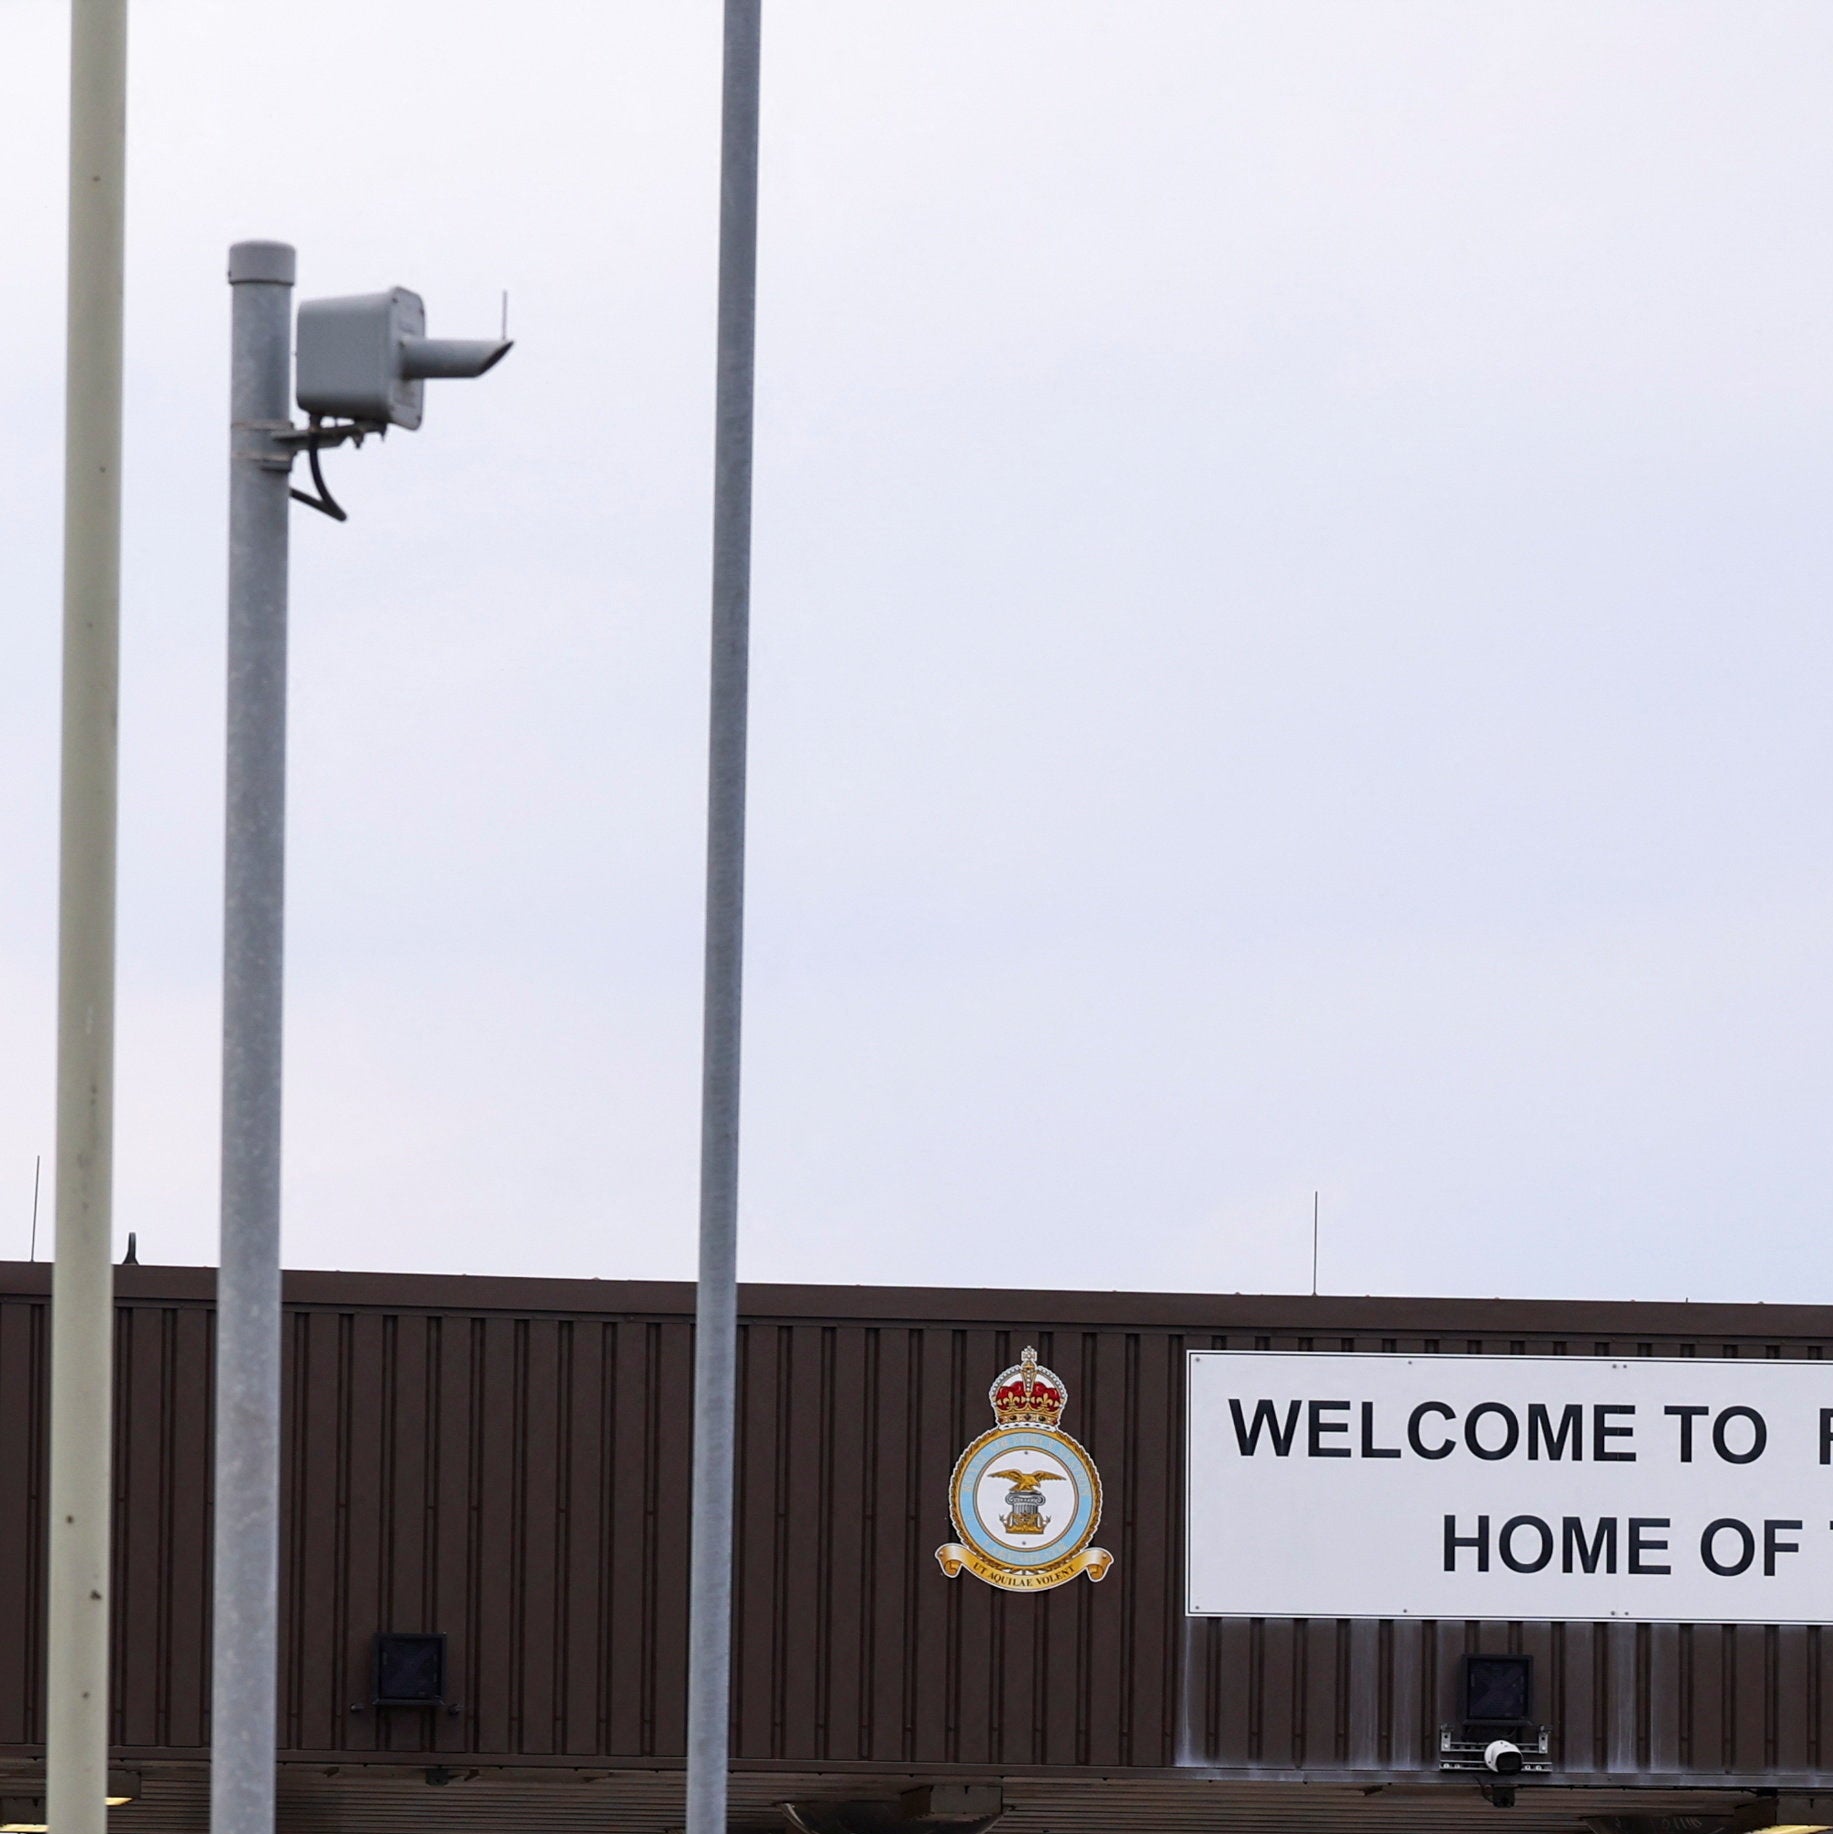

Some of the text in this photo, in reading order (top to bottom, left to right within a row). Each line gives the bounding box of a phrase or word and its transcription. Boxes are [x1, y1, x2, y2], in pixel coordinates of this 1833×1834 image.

[1229, 1399, 1637, 1463] WELCOME
[1664, 1405, 1767, 1464] TO
[973, 1562, 1075, 1587] UT AQUILAE VOLENT
[1444, 1515, 1672, 1575] HOME
[1700, 1518, 1803, 1577] OF
